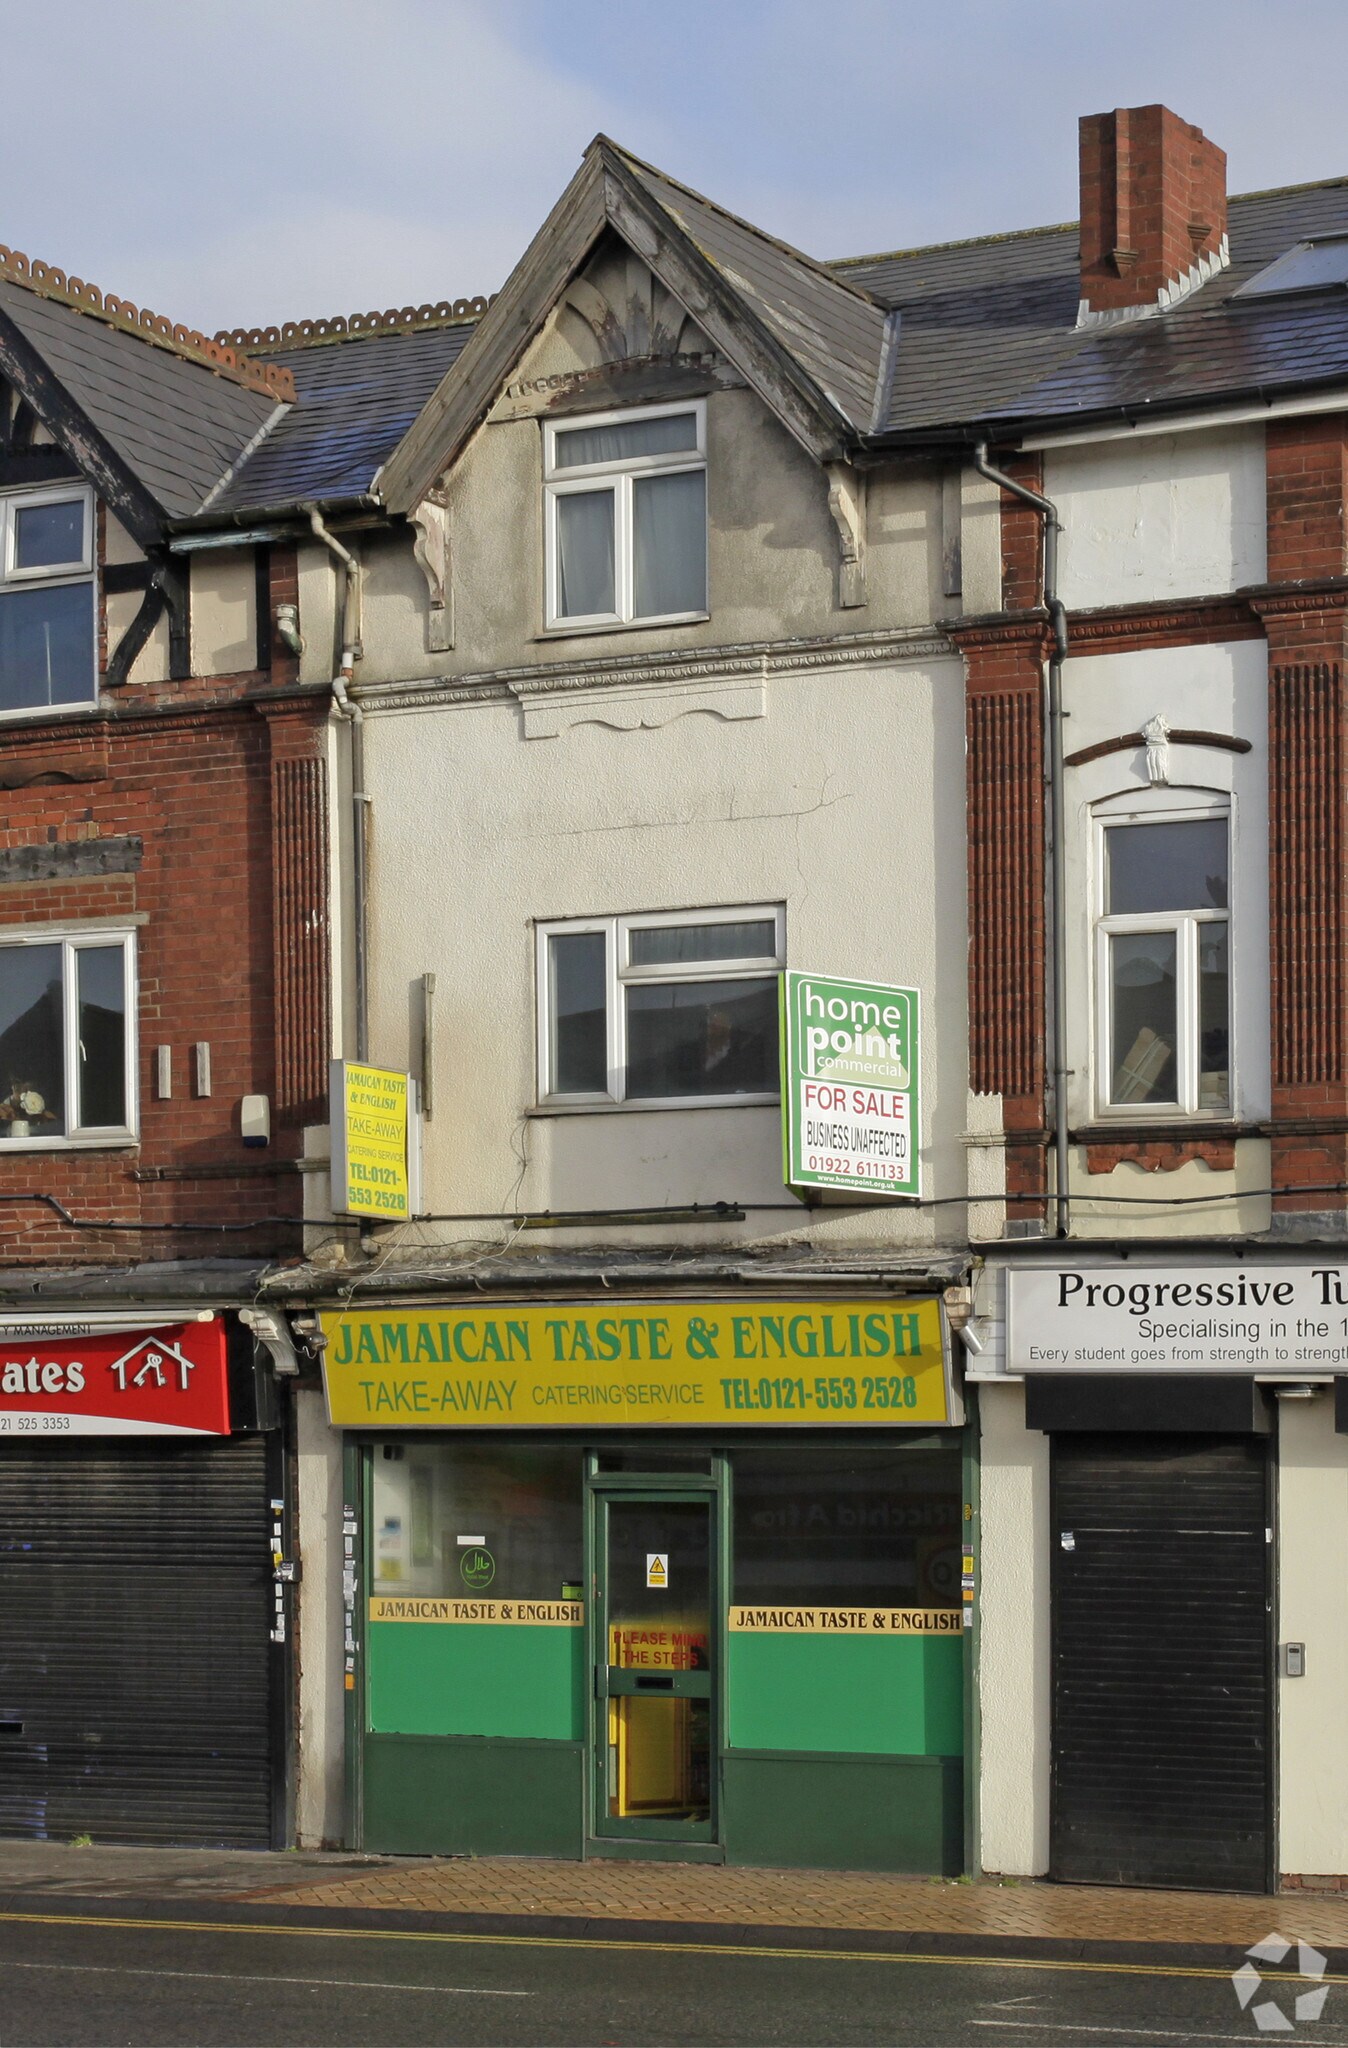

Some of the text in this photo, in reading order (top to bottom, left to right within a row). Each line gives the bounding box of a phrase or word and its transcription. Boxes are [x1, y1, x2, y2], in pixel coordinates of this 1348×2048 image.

[805, 984, 901, 1029] home
[806, 1024, 901, 1076] point
[817, 1054, 902, 1078] commercial
[346, 1071, 406, 1095] JAMAICAN TASTE
[350, 1091, 397, 1111] & ENGLISH
[805, 1084, 905, 1119] FOR SALE
[347, 1116, 402, 1140] TAKE-AWAY
[807, 1120, 906, 1158] BUSINESS UNAFFECTED
[347, 1144, 404, 1163] CATERING SERVICE
[809, 1155, 904, 1180] 01922 611133
[817, 1174, 895, 1190] www.homepoint.org.uk
[349, 1186, 406, 1211] 553 2528
[1058, 1273, 1294, 1316] Progressive
[14, 1324, 92, 1337] MANAGEMENT
[334, 1313, 923, 1365] JAMAICAN TASTE & ENGLISH
[1138, 1318, 1260, 1342] Specialising
[1270, 1318, 1287, 1337] in
[1296, 1318, 1329, 1337] the
[1030, 1346, 1348, 1363] Every student goes from strength to strengt
[358, 1379, 517, 1412] TAKE-AWAY
[532, 1384, 622, 1406] CATERING
[624, 1383, 705, 1405] SERVICE
[861, 1375, 918, 1408] 2528
[18, 1417, 38, 1430] 525
[42, 1417, 71, 1430] 3353
[377, 1601, 580, 1621] JAMAICAN TASTE & ENGLISH
[737, 1610, 815, 1627] JAMAICAN
[819, 1611, 867, 1628] TASTE
[872, 1612, 886, 1629] &
[891, 1612, 961, 1630] ENGLISH
[613, 1631, 707, 1647] PLEASE MIND
[622, 1650, 699, 1666] THE STEPS
